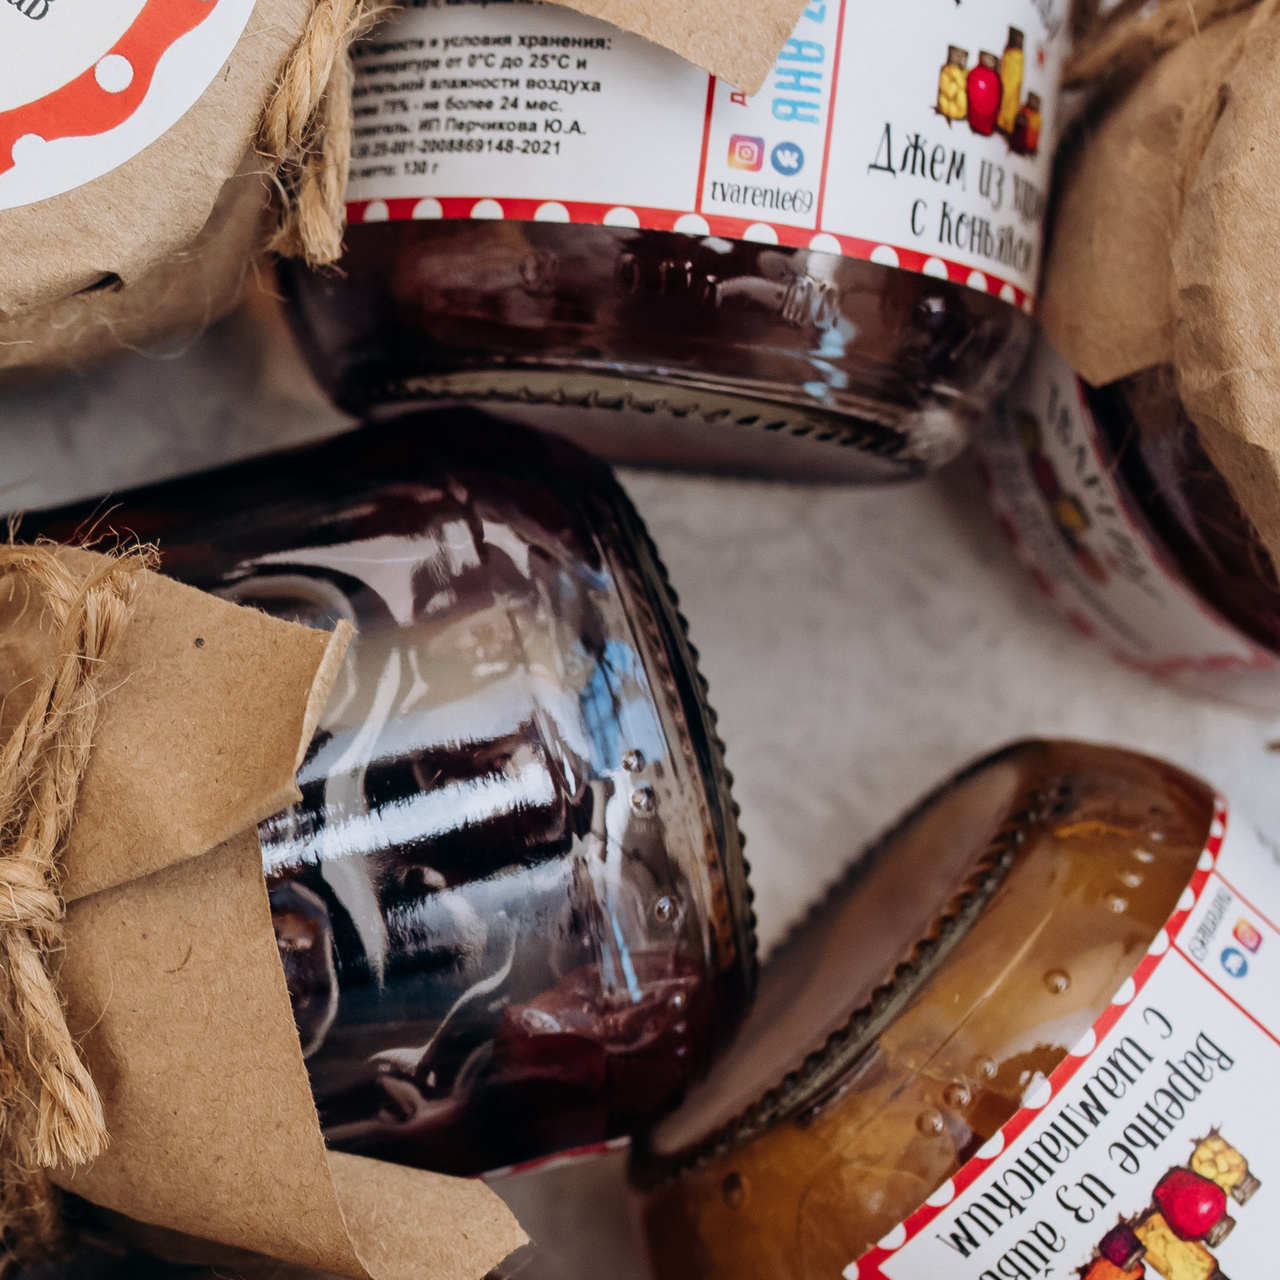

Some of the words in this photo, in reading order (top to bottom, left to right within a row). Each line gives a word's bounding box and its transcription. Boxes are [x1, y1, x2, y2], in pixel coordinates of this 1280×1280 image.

[442, 33, 513, 52] условия
[518, 34, 613, 51] хранения:
[499, 55, 524, 70] до
[575, 58, 588, 70] и
[525, 77, 602, 96] воздуха
[772, 37, 826, 125] ЯНВ
[499, 95, 519, 111] 24
[524, 99, 559, 112] мес.
[443, 115, 538, 135] Перчикова
[543, 117, 587, 136] Ю.А.
[867, 123, 967, 191] Джем
[710, 180, 814, 213] tvarenie69
[910, 199, 927, 237] с
[1142, 1006, 1173, 1040] с
[1107, 1031, 1235, 1175] Варенье
[934, 1036, 1154, 1260] шампанским
[1055, 1172, 1117, 1225] из
